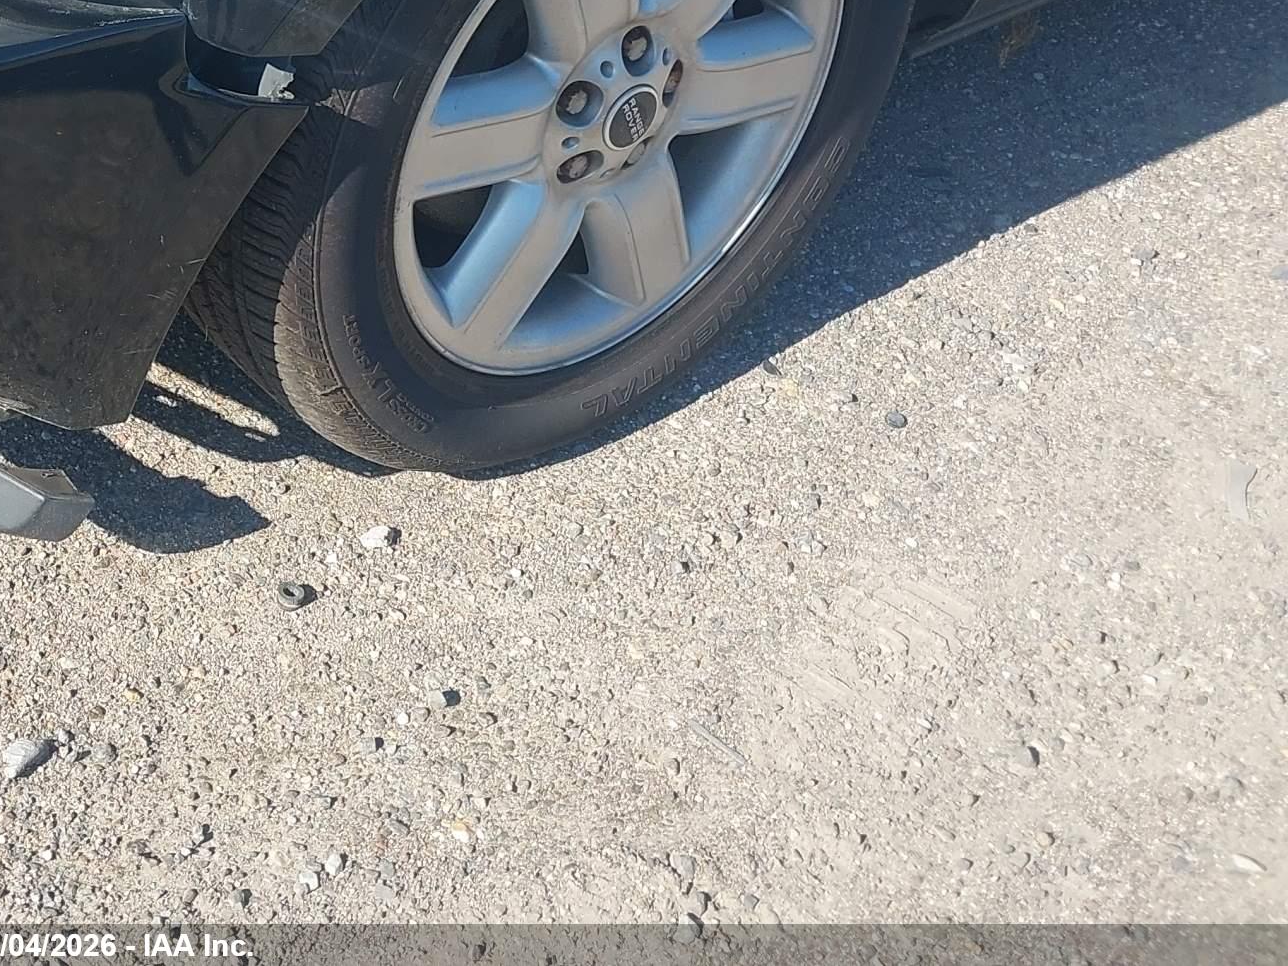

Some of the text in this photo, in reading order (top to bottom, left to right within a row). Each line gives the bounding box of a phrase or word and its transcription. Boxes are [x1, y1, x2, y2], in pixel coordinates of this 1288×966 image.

[621, 103, 640, 142] ROVER
[628, 97, 646, 137] RANGE
[578, 134, 852, 419] CONTINENTAL
